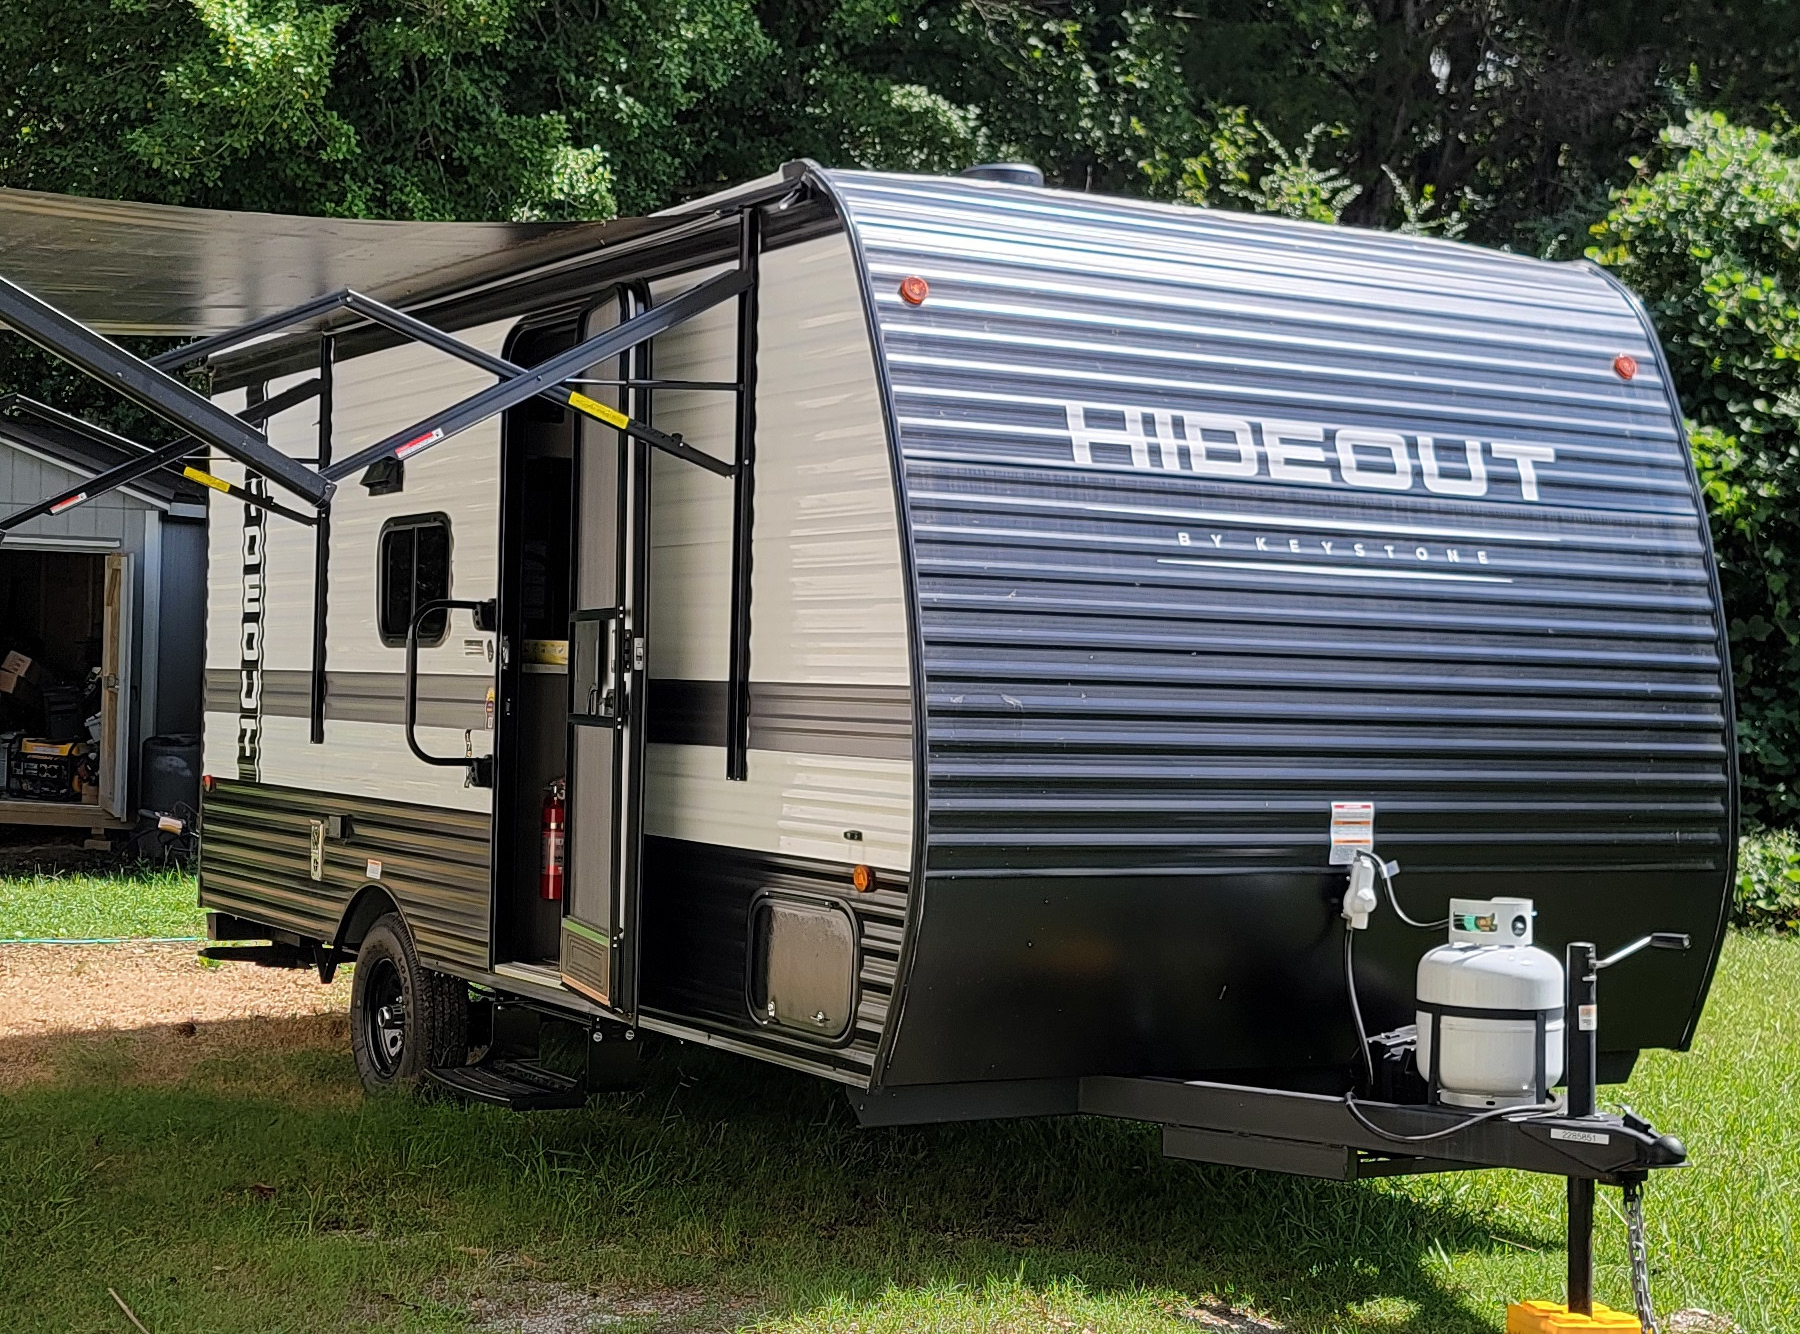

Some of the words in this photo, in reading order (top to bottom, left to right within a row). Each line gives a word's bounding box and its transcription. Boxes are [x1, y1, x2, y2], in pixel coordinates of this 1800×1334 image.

[1066, 404, 1556, 501] HIDEOUT
[239, 427, 262, 757] IDEOUT
[1177, 532, 1222, 548] BY
[1255, 536, 1490, 565] KEYSTONE
